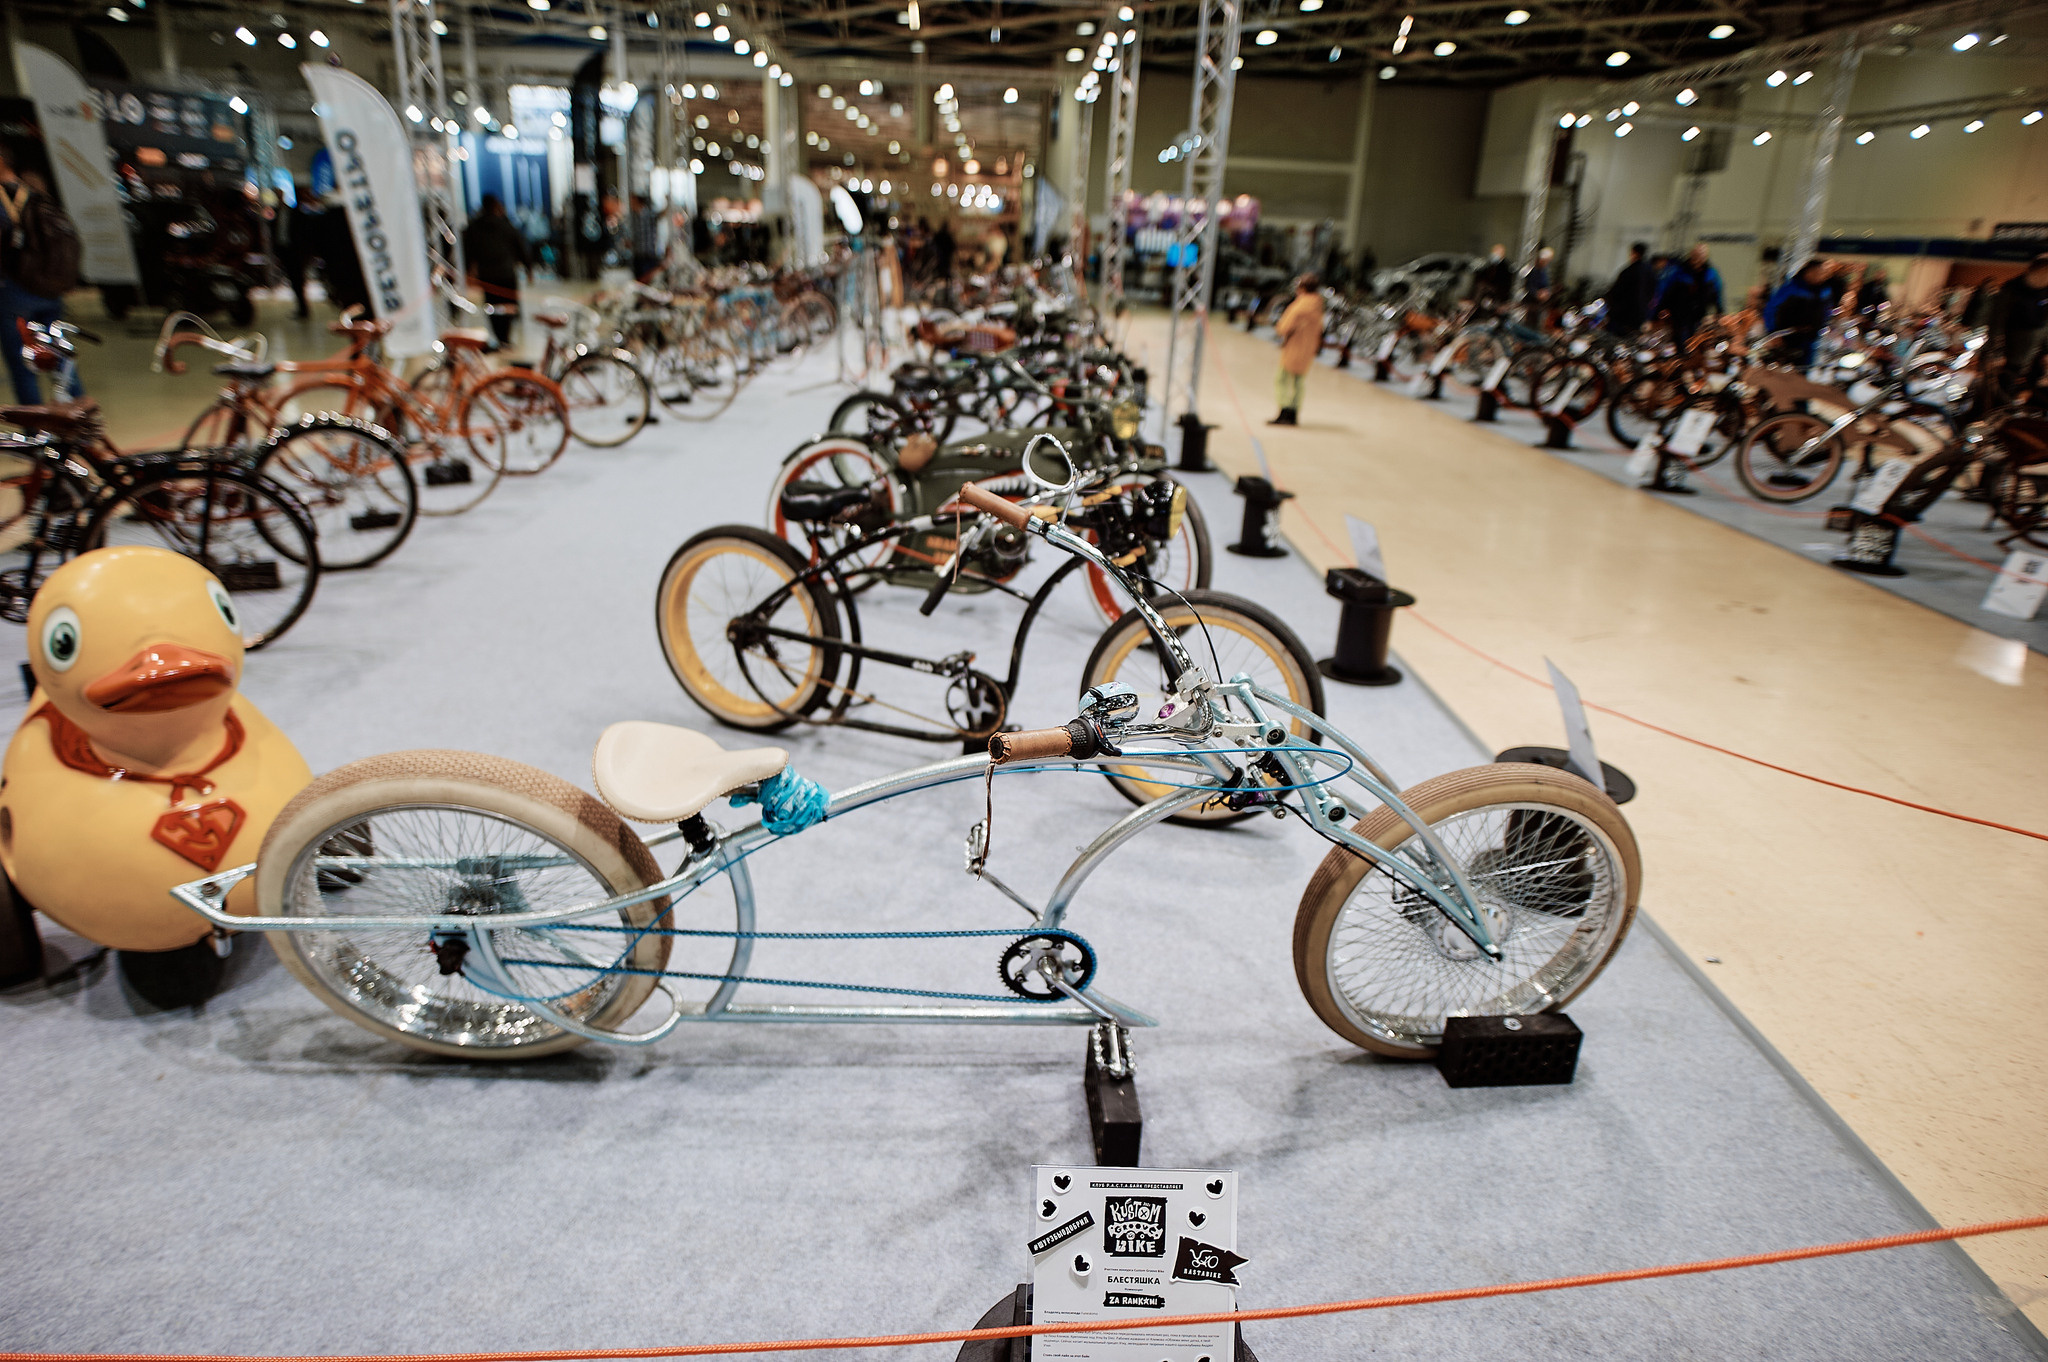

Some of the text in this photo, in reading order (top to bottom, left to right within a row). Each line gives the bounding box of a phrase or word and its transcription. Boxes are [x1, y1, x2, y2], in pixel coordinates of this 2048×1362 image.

[1109, 1198, 1162, 1222] KUSTOM
[1115, 1239, 1156, 1253] BIKE
[1183, 1268, 1222, 1279] RASTABIKE
[1107, 1275, 1160, 1285] БЛЕСТЯШКА
[1109, 1296, 1120, 1304] ZA
